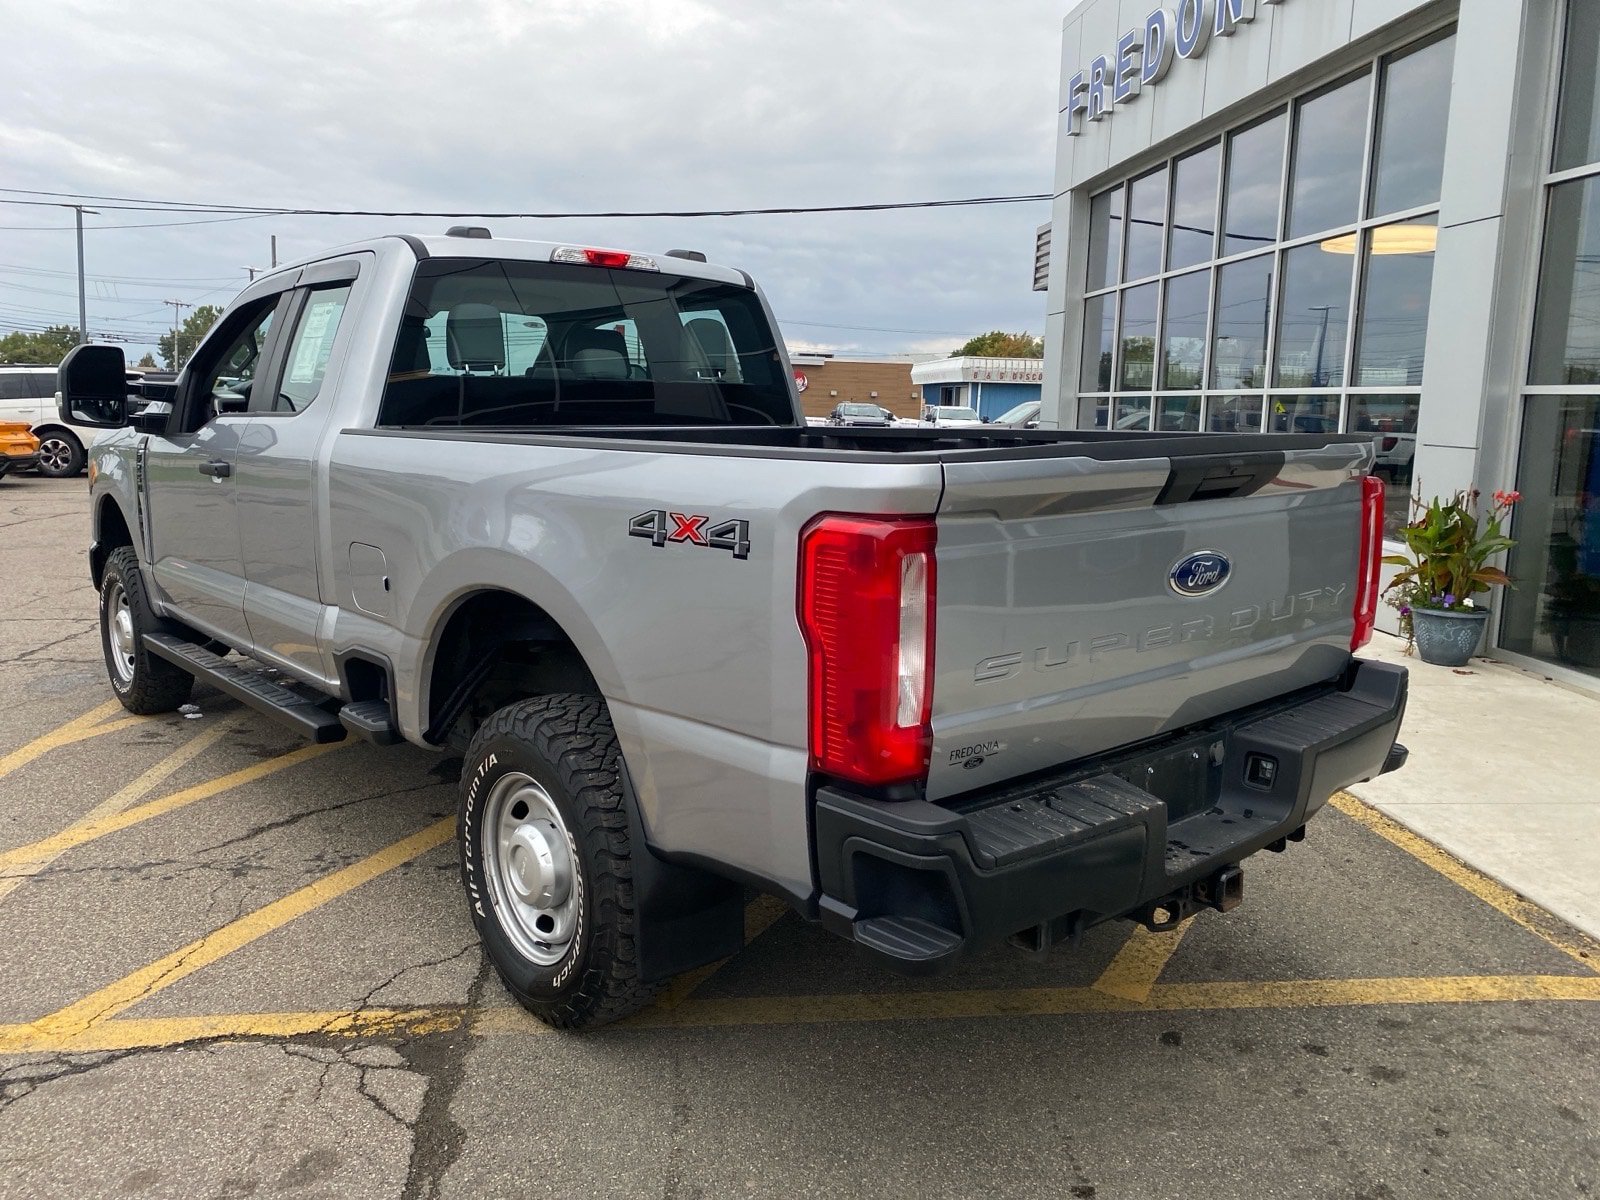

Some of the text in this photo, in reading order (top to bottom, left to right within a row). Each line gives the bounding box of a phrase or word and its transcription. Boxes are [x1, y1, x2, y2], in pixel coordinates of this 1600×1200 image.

[973, 582, 1347, 687] SUPER DUTY
[949, 740, 999, 761] FREDONIA
[464, 752, 499, 918] All-Terrain T/A
